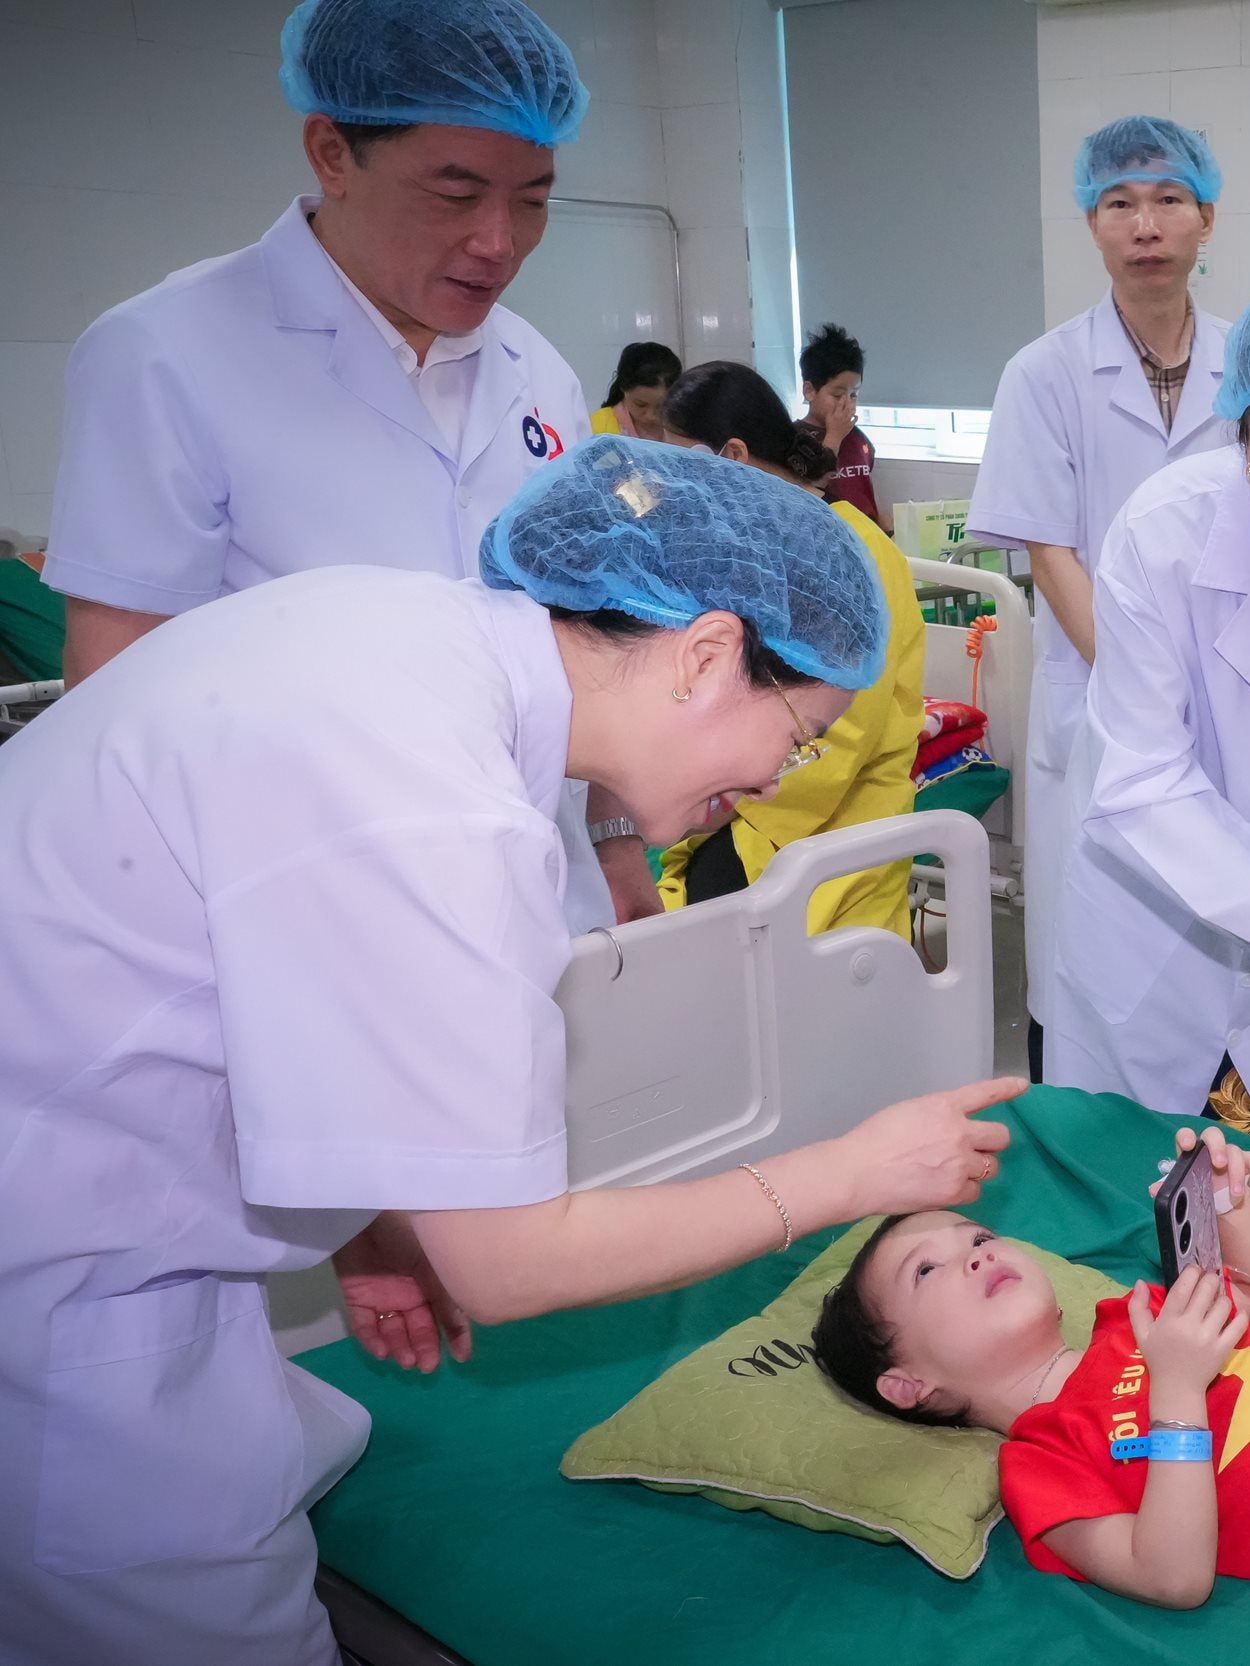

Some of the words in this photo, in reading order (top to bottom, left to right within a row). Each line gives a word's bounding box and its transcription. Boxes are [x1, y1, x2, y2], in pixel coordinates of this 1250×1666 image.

[831, 464, 870, 479] KETB
[1112, 1364, 1146, 1401] ÊU
[1108, 1411, 1140, 1455] ÔI
